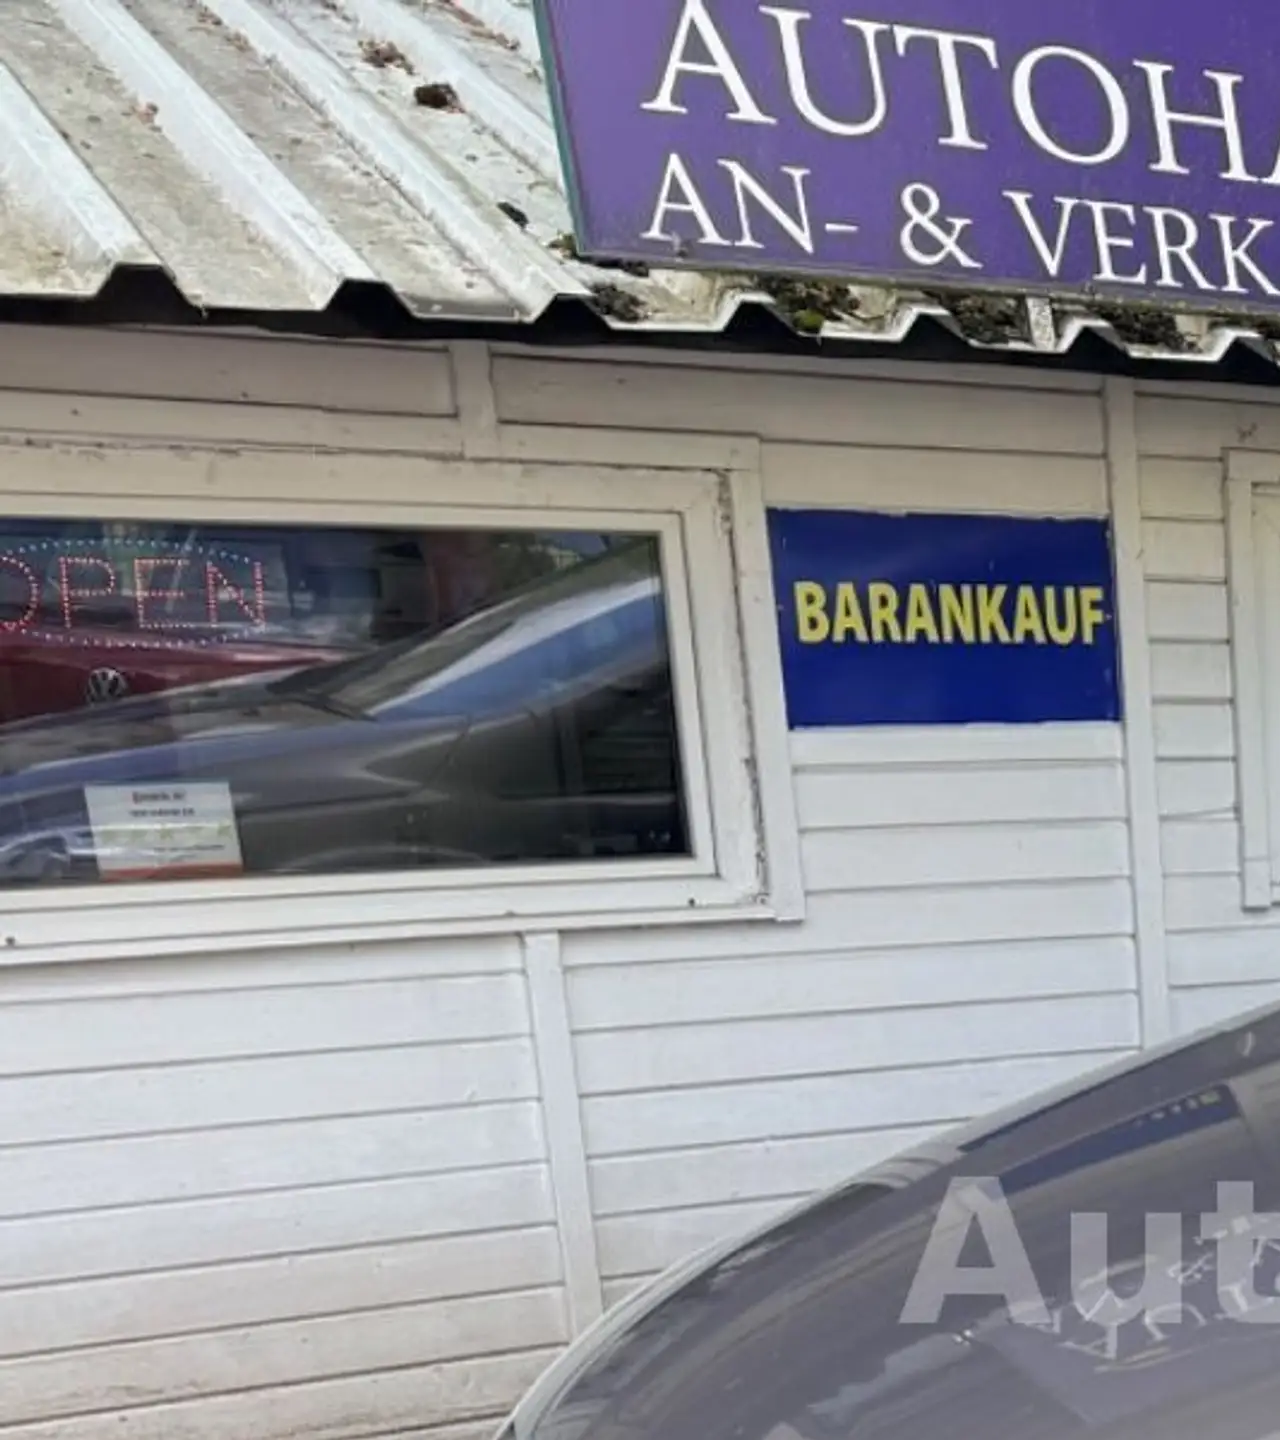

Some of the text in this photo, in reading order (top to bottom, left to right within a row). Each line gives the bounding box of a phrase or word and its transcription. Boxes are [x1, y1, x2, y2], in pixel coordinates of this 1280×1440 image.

[641, 152, 860, 255] AN-
[899, 182, 983, 270] &
[793, 579, 1105, 646] BARANKAUF
